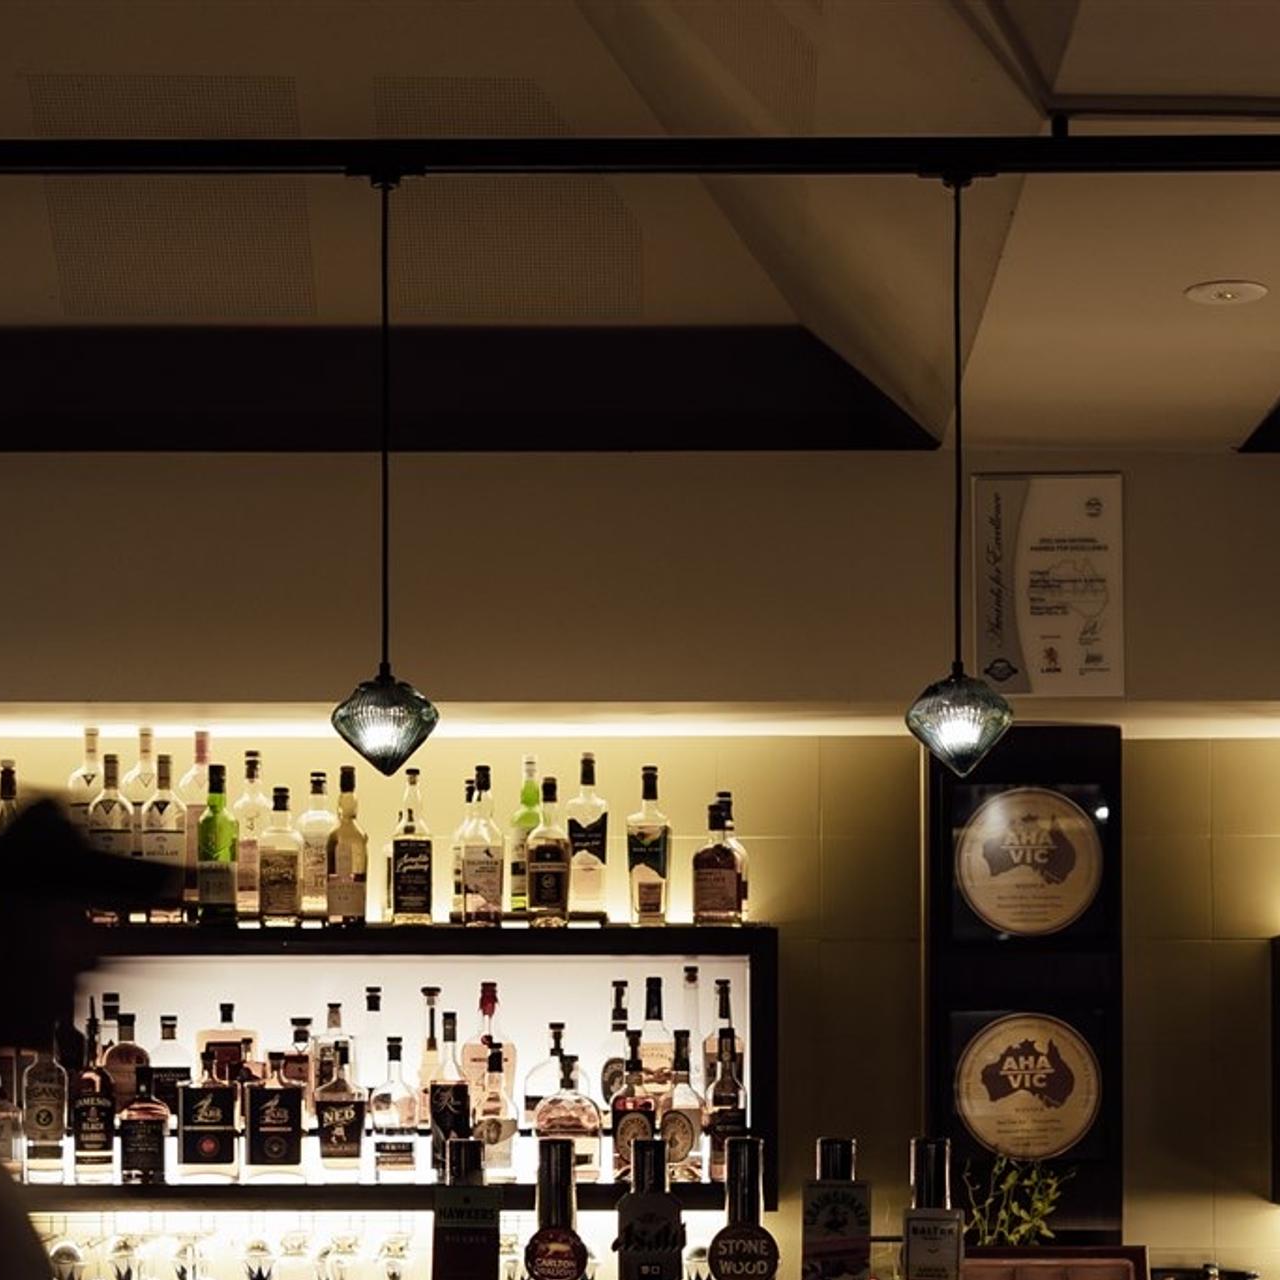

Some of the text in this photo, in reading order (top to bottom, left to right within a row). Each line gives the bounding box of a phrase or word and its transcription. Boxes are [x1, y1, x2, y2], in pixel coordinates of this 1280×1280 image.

[1003, 830, 1054, 846] AHA
[1008, 849, 1050, 864] VIC
[1001, 1055, 1052, 1070] AHA
[1007, 1074, 1048, 1089] VIC
[323, 1107, 356, 1125] NED
[439, 1207, 495, 1219] HAWKERS
[718, 1238, 770, 1255] STONE
[720, 1260, 769, 1276] WOOD
